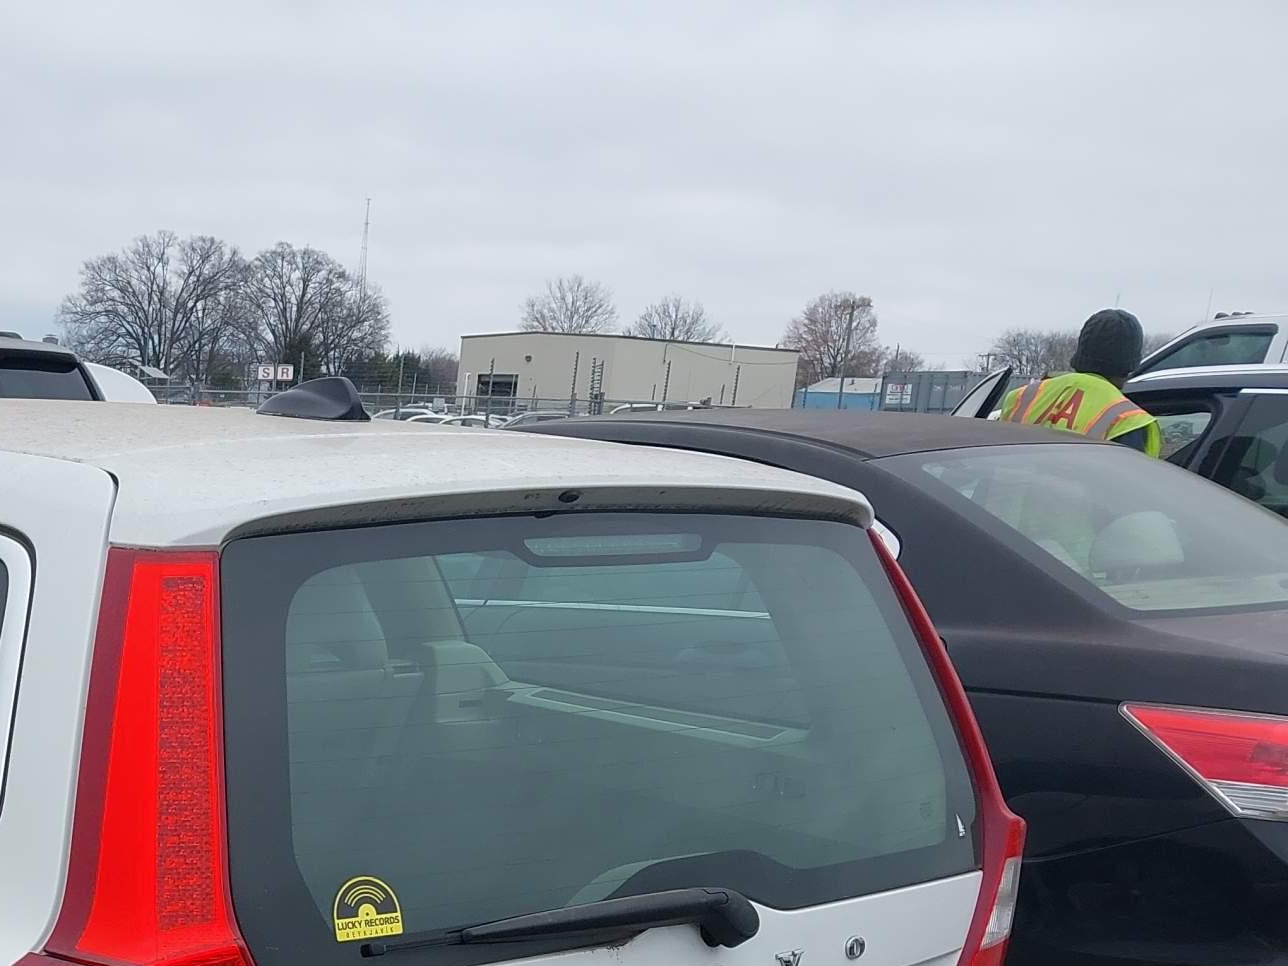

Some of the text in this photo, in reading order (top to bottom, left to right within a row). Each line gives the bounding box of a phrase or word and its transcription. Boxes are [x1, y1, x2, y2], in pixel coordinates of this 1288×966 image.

[262, 367, 289, 378] S R
[337, 915, 400, 931] LUCKY RECORDS
